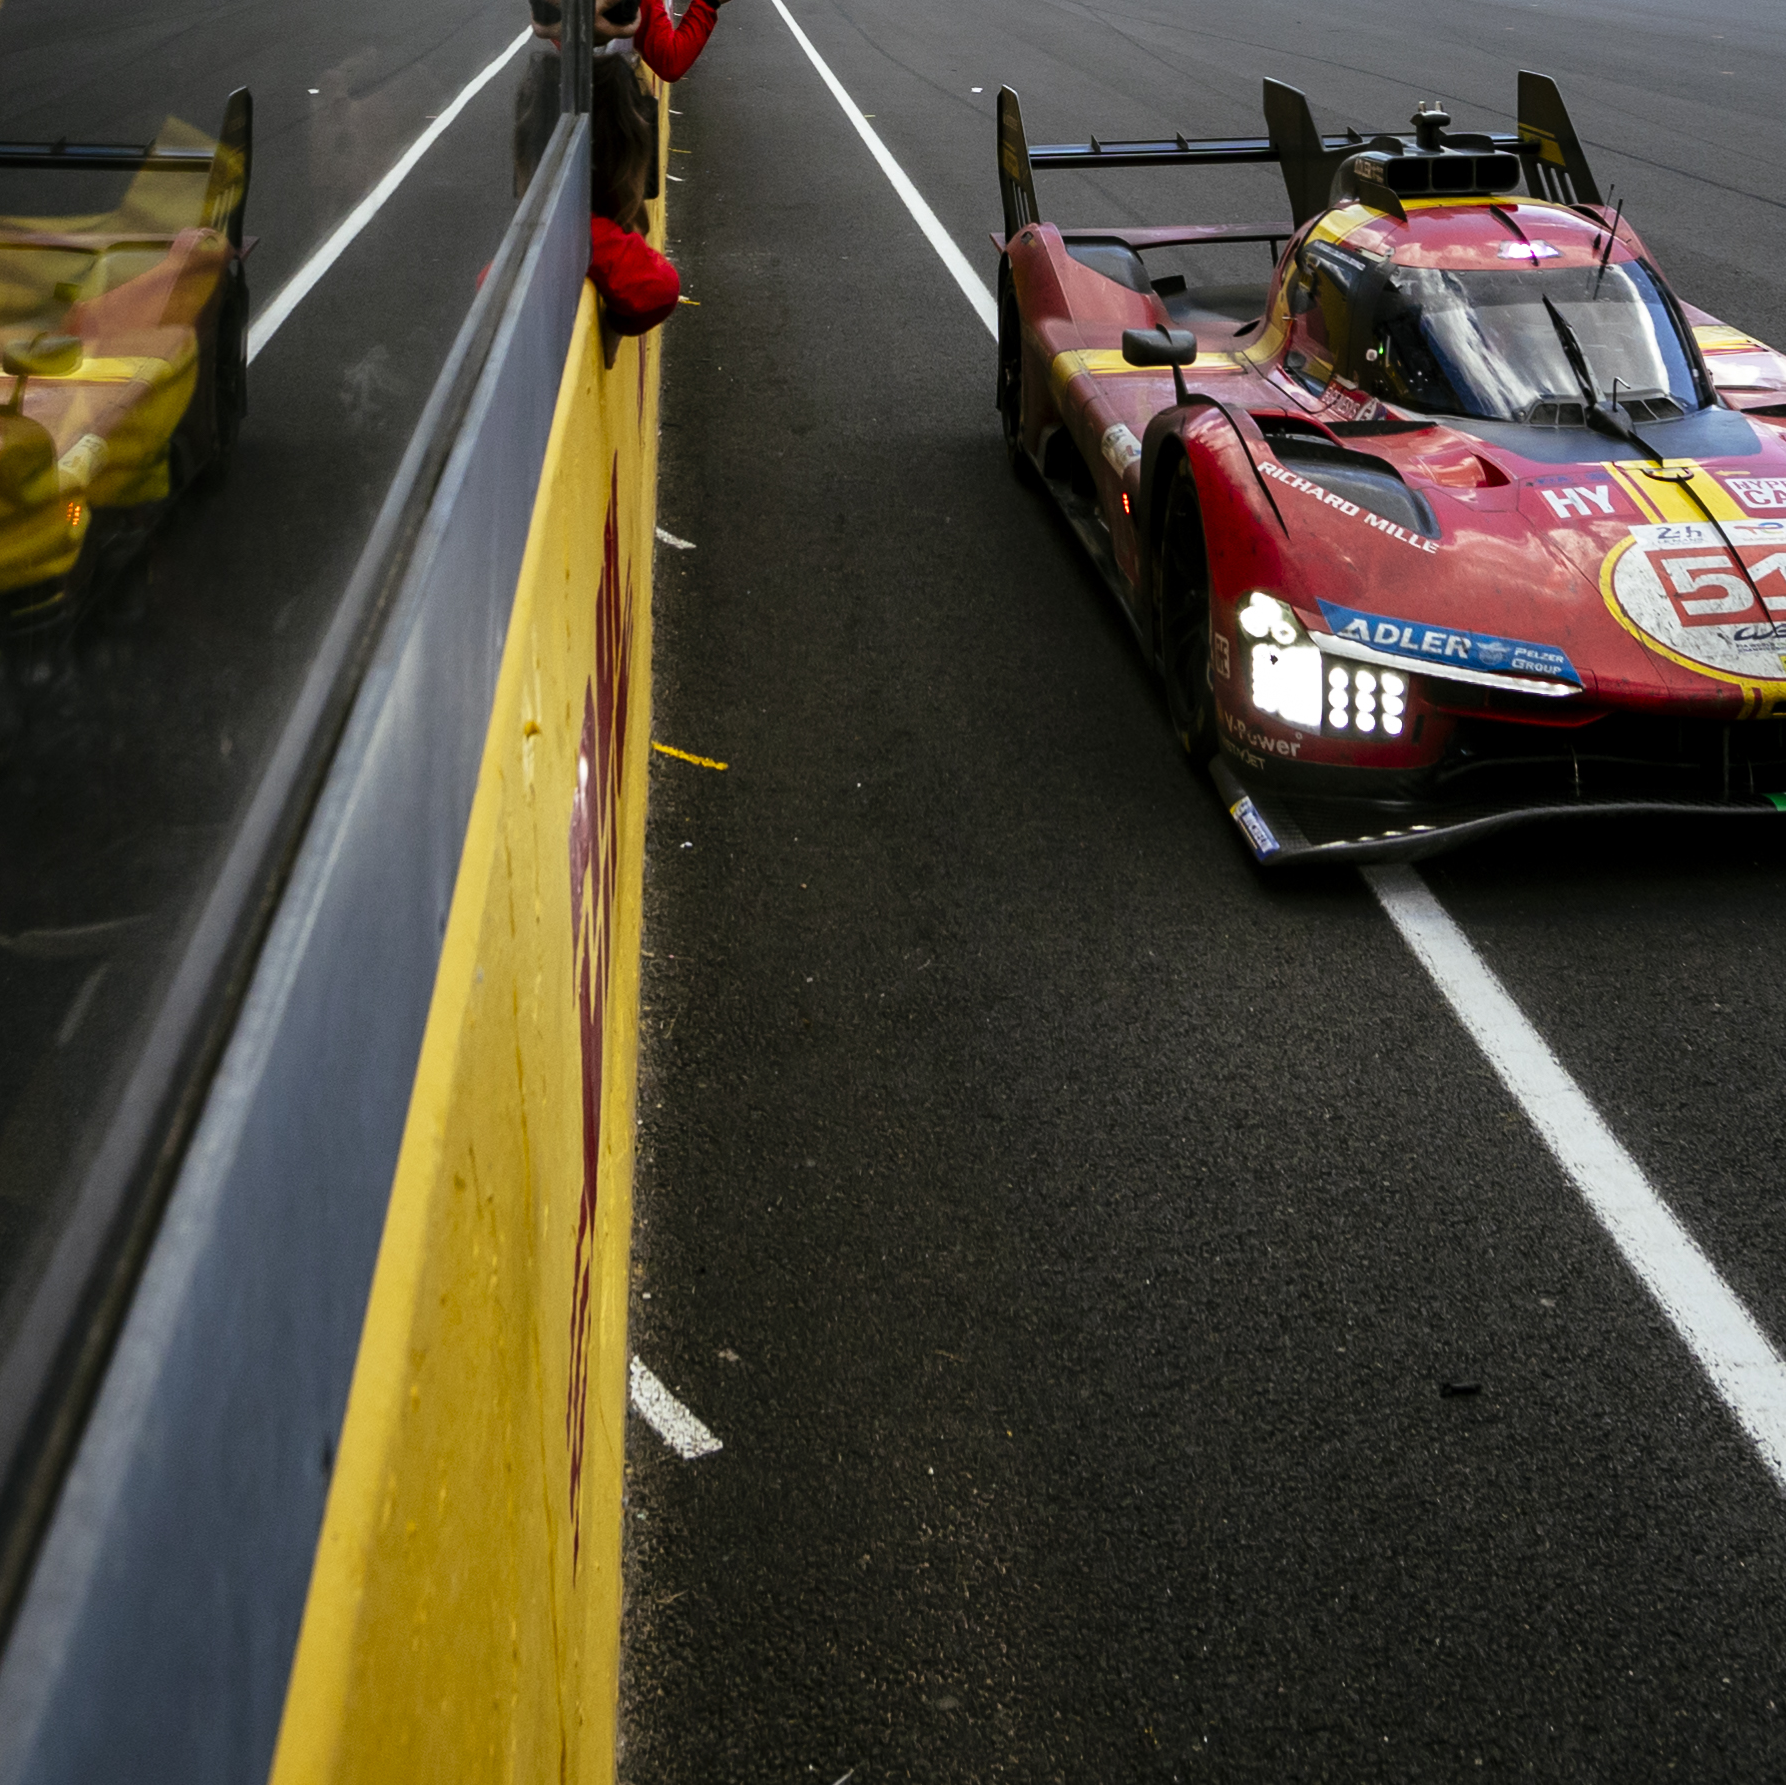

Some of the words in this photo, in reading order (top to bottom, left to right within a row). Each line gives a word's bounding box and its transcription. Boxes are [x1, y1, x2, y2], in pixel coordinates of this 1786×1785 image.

[1258, 461, 1360, 517] RICHARD
[1364, 511, 1440, 555] MILLE
[1541, 484, 1615, 518] HY
[1336, 618, 1471, 659] ADLER
[1514, 647, 1564, 664] PELZER
[1511, 659, 1562, 675] GROUP
